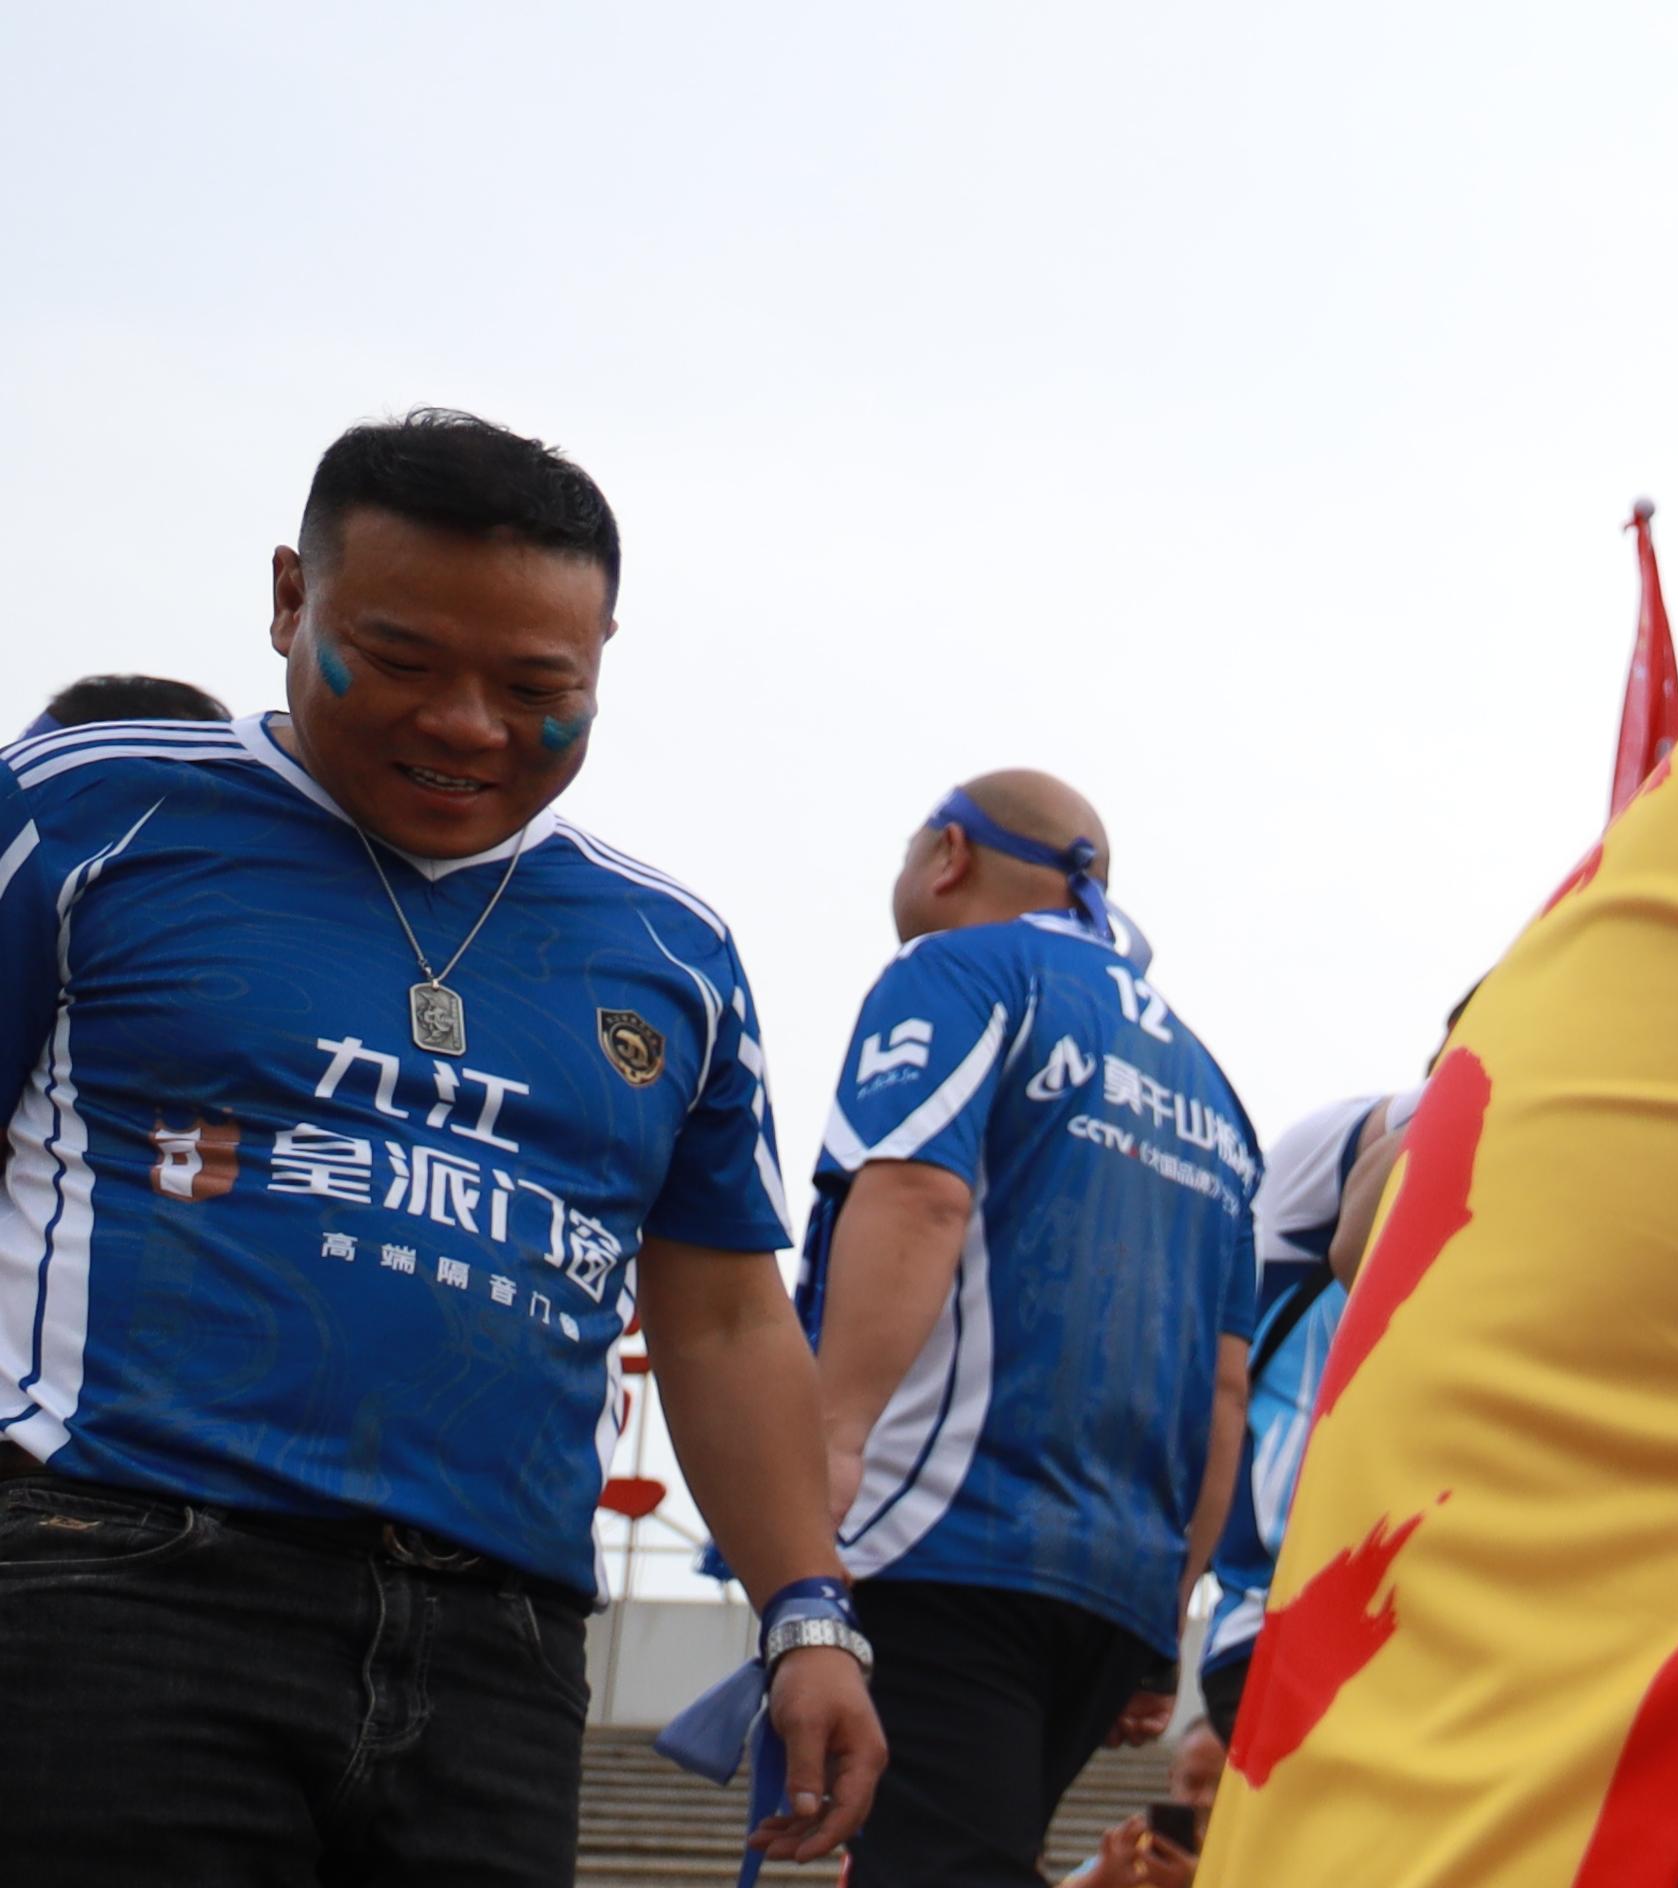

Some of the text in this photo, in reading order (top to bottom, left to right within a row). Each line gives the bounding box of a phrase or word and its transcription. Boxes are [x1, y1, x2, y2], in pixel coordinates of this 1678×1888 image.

[1107, 965, 1174, 1044] 12
[315, 1035, 531, 1153] 九江
[1067, 1114, 1134, 1155] CCTV
[267, 1122, 627, 1303] 皇派门窗
[321, 1231, 580, 1343] 高端隔音门窗
